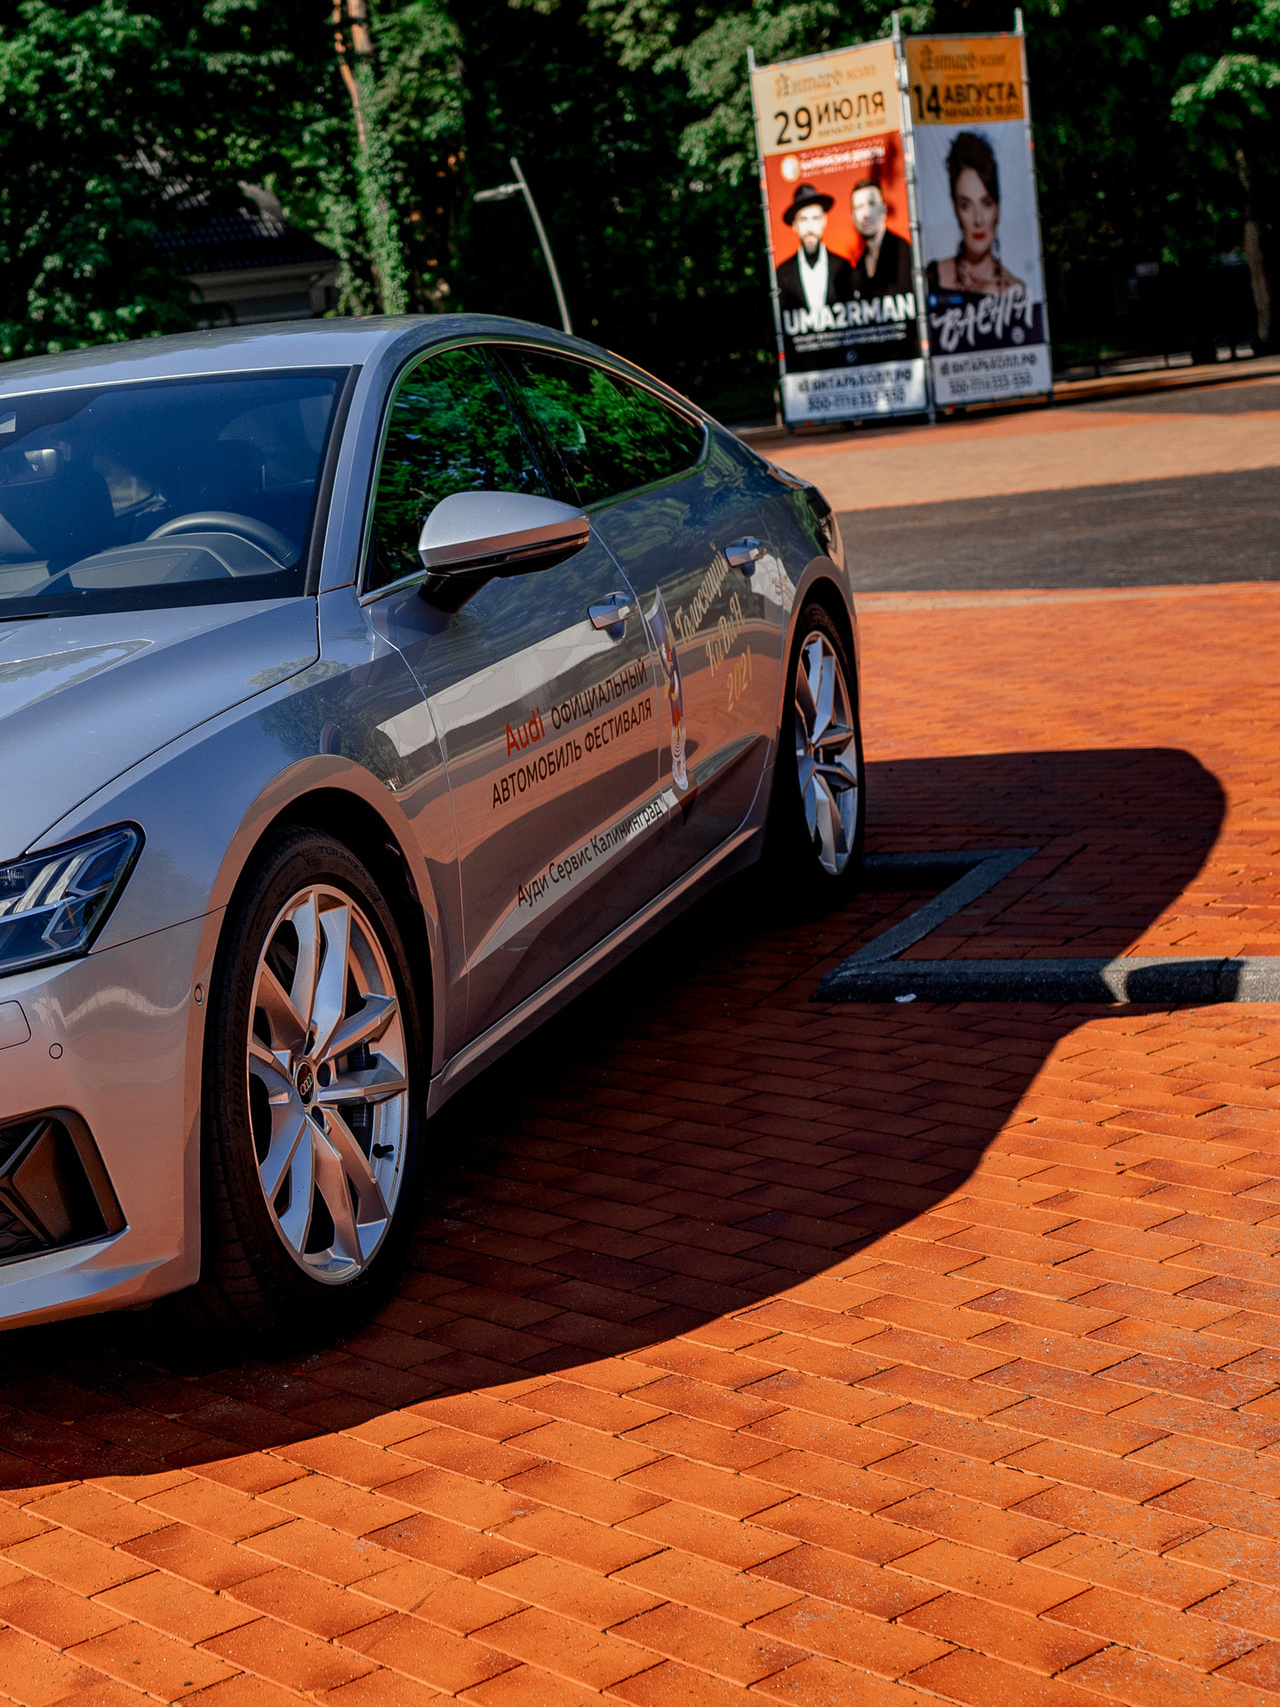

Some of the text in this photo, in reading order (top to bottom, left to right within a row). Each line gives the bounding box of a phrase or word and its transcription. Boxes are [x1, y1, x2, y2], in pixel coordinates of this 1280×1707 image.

[817, 91, 885, 124] ИЮЛЯ
[913, 84, 942, 119] 14
[944, 81, 1019, 103] АВГУСТА
[774, 107, 812, 146] 29
[783, 292, 916, 336] UMA2RMAN
[727, 644, 753, 713] 2021
[505, 658, 648, 757] Audi ОФИЦИАЛЬНЫЙ
[492, 698, 653, 809] АВТОМОБИЛЬ ФЕСТИВАЛЯ
[517, 801, 664, 907] Ауди Сервис Калининград
